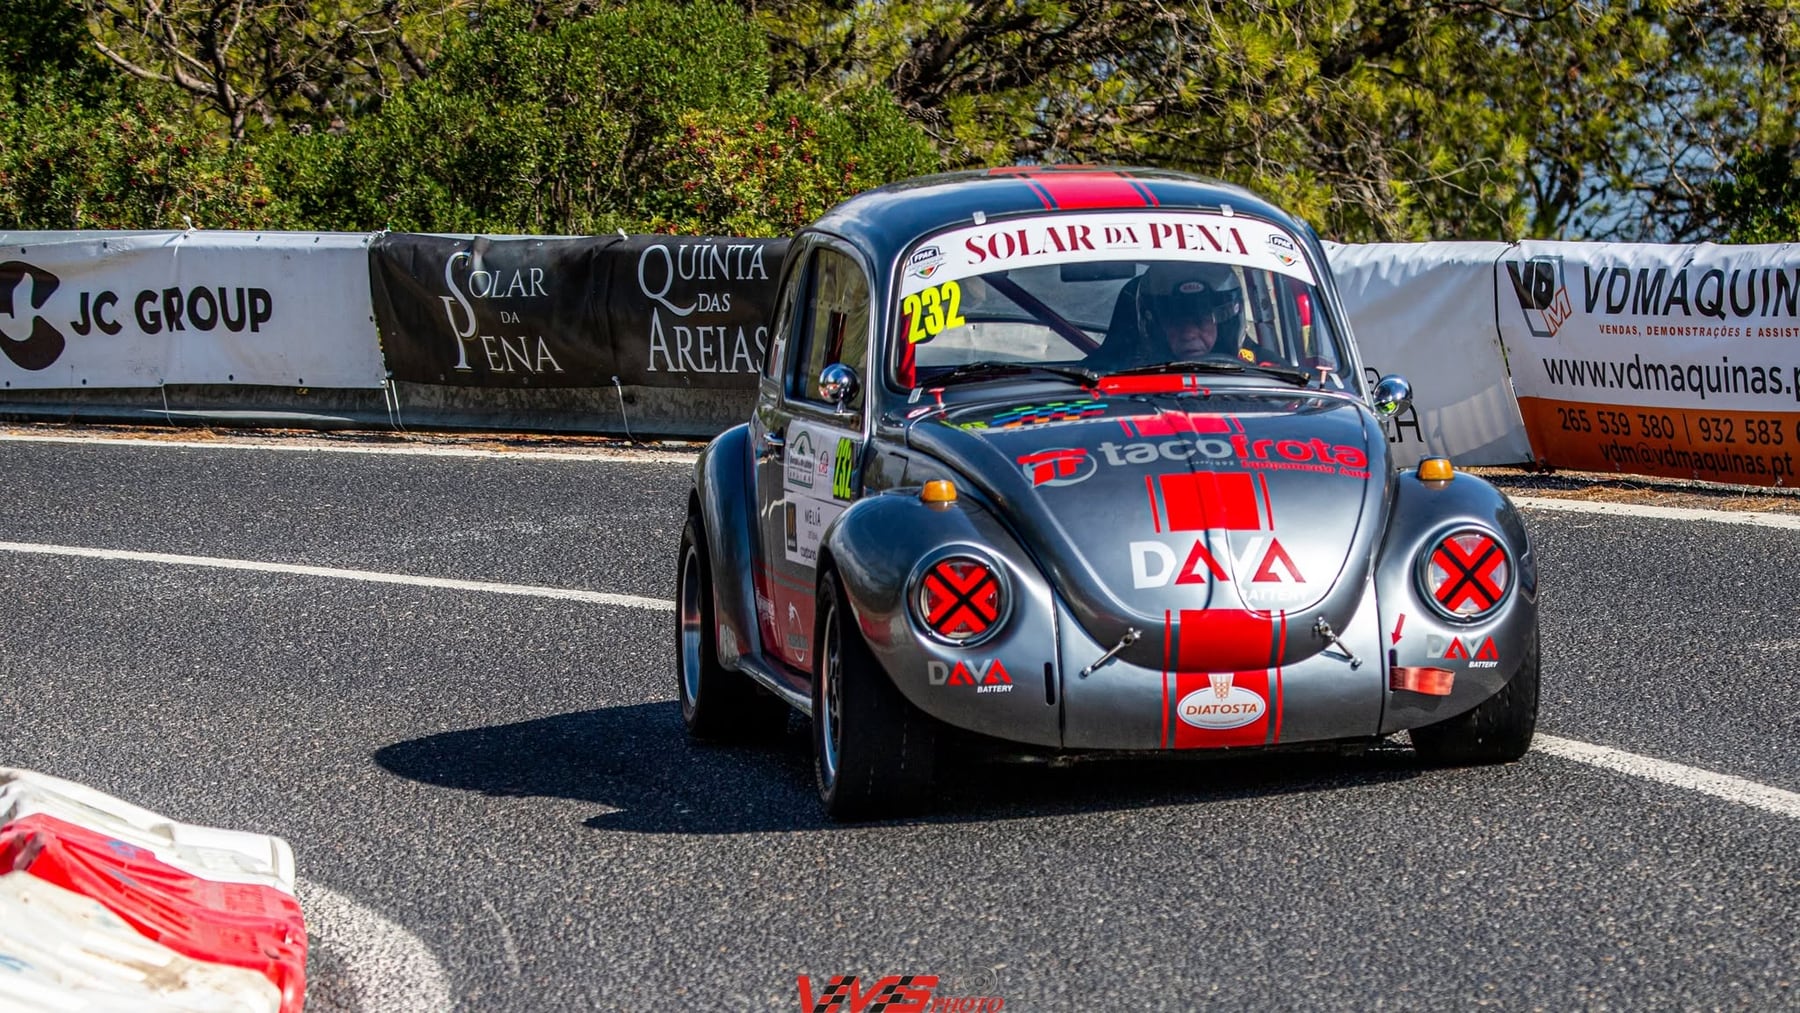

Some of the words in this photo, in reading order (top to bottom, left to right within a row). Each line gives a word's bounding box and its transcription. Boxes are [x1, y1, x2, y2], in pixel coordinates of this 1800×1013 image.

[965, 225, 1096, 264] SOLAR
[1104, 227, 1139, 243] DA
[1148, 223, 1249, 256] PENA
[445, 251, 548, 338] SOLAR
[638, 244, 769, 317] QUINTA
[70, 290, 123, 336] JC
[134, 285, 273, 335] GROUP
[500, 311, 520, 324] DA
[698, 293, 731, 312] DAS
[903, 280, 966, 344] 232
[438, 296, 565, 375] PENA
[647, 307, 768, 374] AREIAS
[1599, 325, 1642, 337] VENDAS,
[1646, 325, 1741, 339] DEMONSTRAÇÕES
[1745, 327, 1752, 337] E
[1557, 407, 1592, 433] 265
[1597, 411, 1631, 436] 539
[1637, 414, 1675, 440] 380
[1699, 417, 1736, 443] 932
[1745, 419, 1784, 445] 583
[833, 437, 852, 498] 232
[1097, 434, 1368, 468] tacofrota
[1599, 440, 1794, 480] vdm@vdmaquinas.pt
[1129, 537, 1307, 589] DAVA
[1426, 634, 1499, 660] DAVA
[928, 657, 1013, 686] DAVA
[977, 685, 1013, 693] BATTERY
[1186, 703, 1257, 715] DIATOSTA
